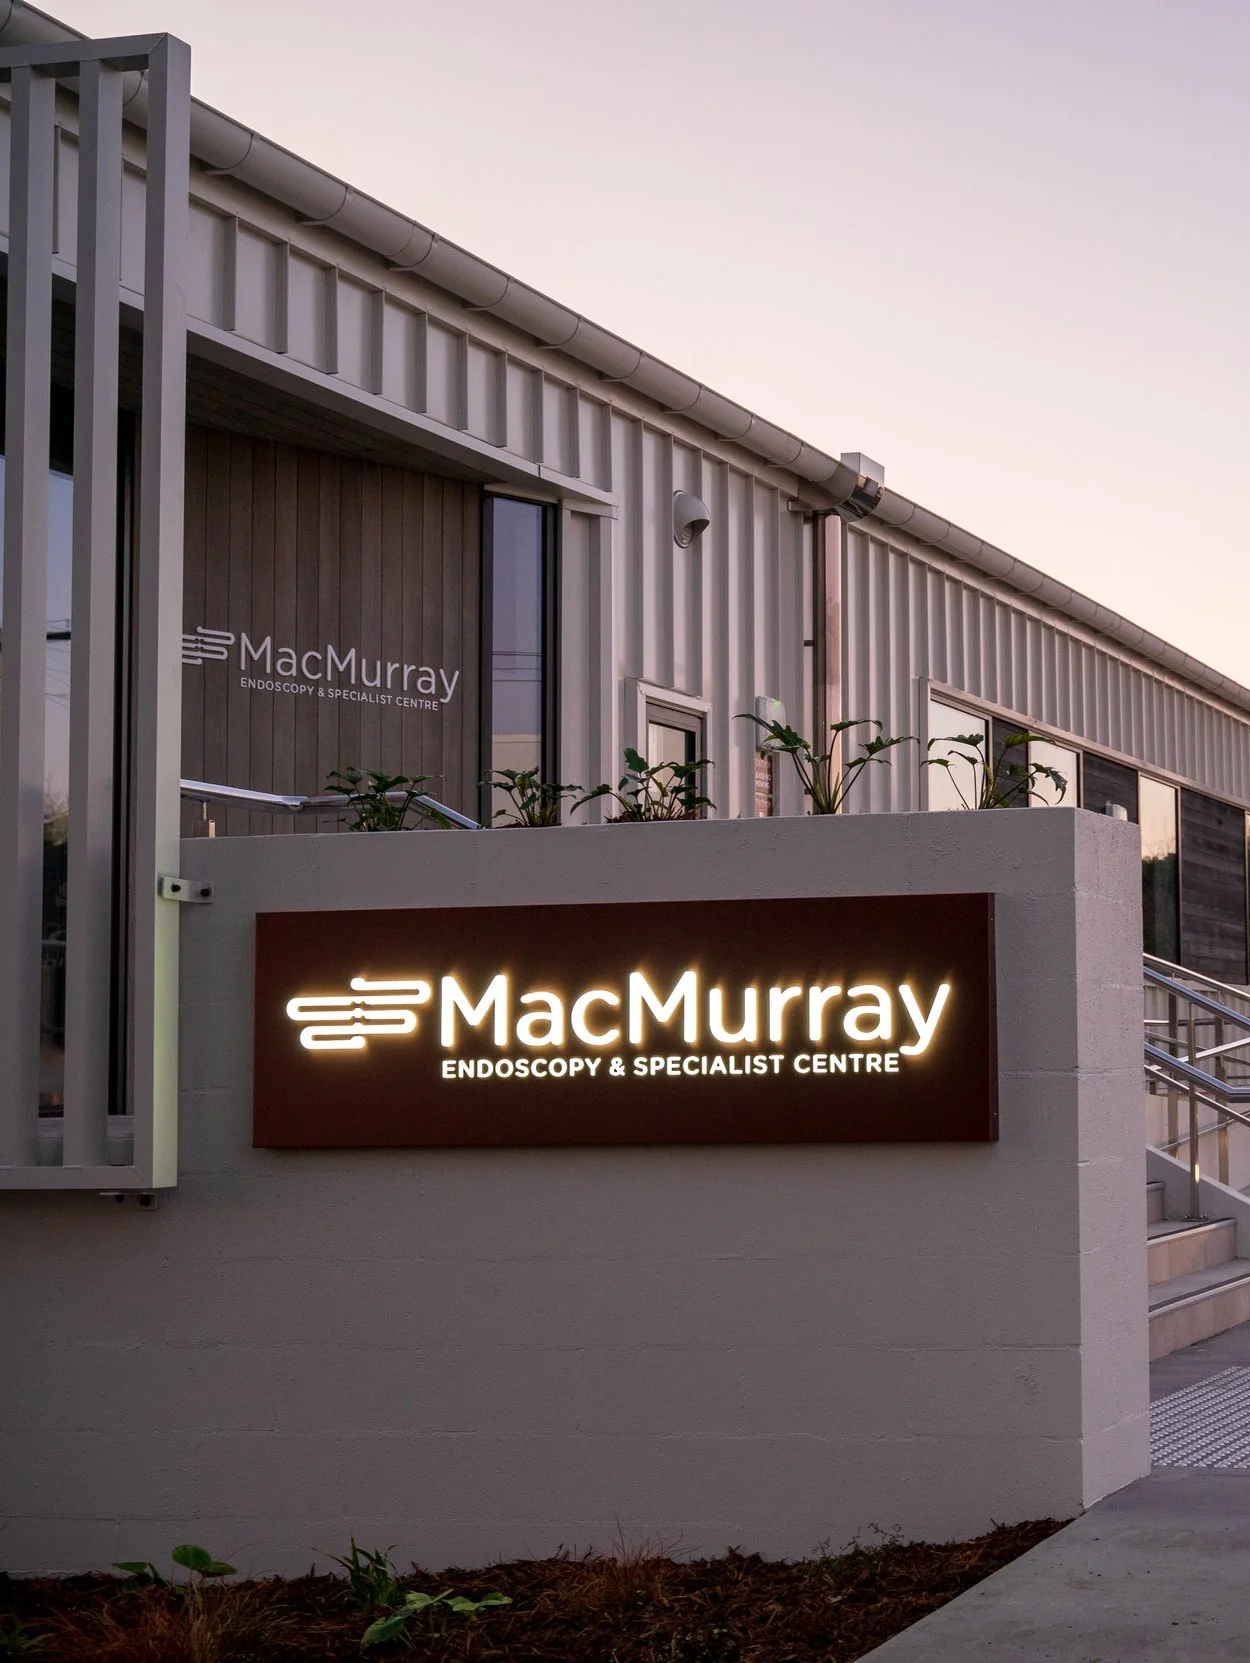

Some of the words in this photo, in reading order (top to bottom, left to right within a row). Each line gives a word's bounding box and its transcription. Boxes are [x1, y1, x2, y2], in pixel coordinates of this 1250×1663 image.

[240, 632, 460, 704] MacMurray
[240, 677, 315, 696] ENDOSCOPY
[317, 687, 325, 698] &
[327, 688, 393, 706] SPECIALIST
[395, 696, 439, 711] CENTRE
[439, 970, 952, 1057] MacMurray
[441, 1057, 602, 1079] ENDOSCOPY
[608, 1056, 626, 1077] &
[632, 1054, 785, 1077] SPECIALIST
[793, 1052, 901, 1074] CENTRE
